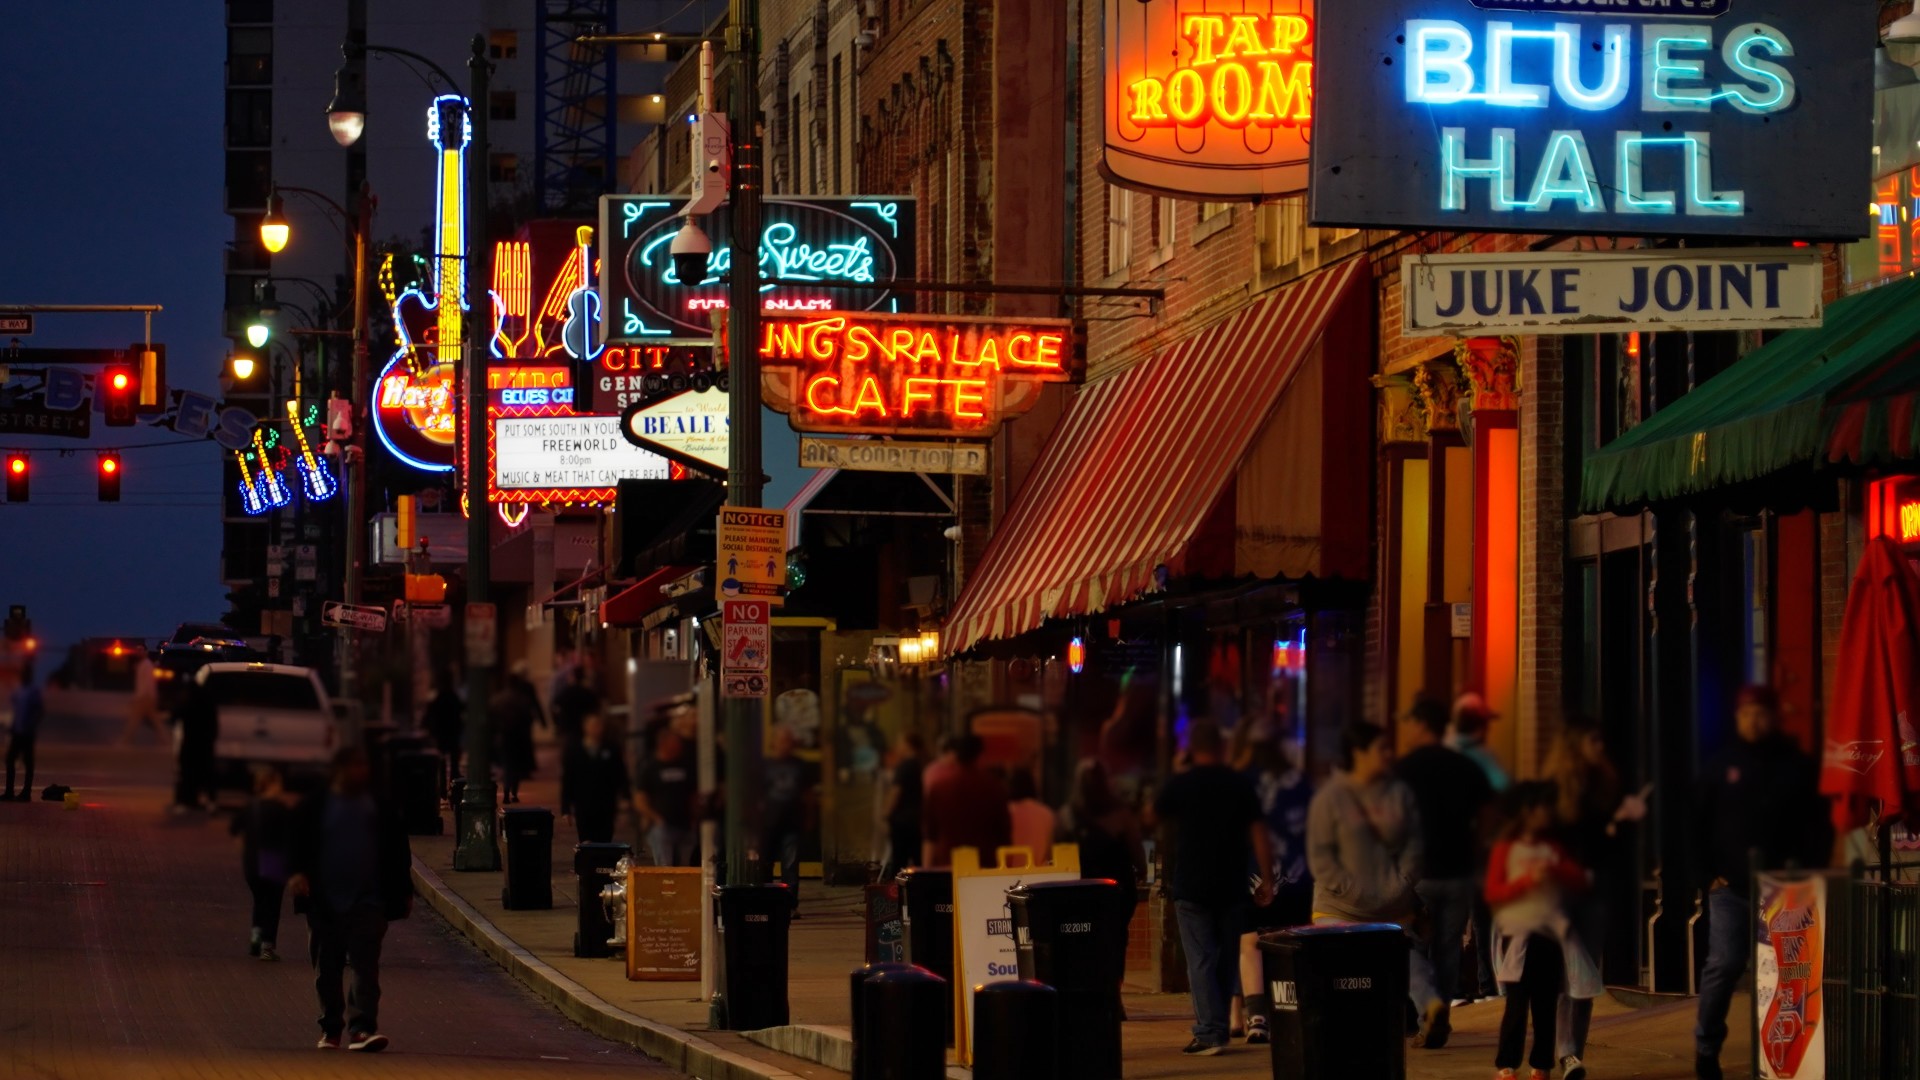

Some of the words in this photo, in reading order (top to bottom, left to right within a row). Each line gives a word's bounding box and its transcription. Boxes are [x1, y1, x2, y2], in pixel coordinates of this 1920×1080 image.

[1183, 13, 1312, 66] TAP
[1406, 19, 1796, 115] BLUES
[1129, 61, 1313, 124] ROOM
[1441, 127, 1746, 216] HALL
[763, 222, 876, 283] Sweets
[1436, 267, 1581, 316] JUKE
[1618, 262, 1789, 312] JOINT
[764, 298, 831, 310] SHACK
[9, 320, 26, 328] WAY
[381, 375, 451, 408] Hard
[502, 388, 549, 404] BLUES
[807, 376, 986, 417] CAFE
[44, 367, 259, 450] BES
[505, 424, 516, 436] PUT
[523, 424, 546, 436] SOME
[549, 423, 576, 436] SOUTH
[580, 423, 590, 434] IN
[594, 421, 621, 434] YOUR
[643, 416, 715, 434] BEALE
[543, 439, 617, 451] FREEWORLD
[560, 455, 592, 466] 8:00pm
[806, 444, 839, 463] AIR
[849, 446, 979, 468] CONDITIOND
[502, 472, 529, 484] MUSIC
[533, 472, 540, 483] &
[545, 470, 569, 483] MEAT
[573, 470, 595, 482] THAT
[725, 513, 782, 527] NOTICE
[725, 534, 747, 542] PLEASE
[749, 535, 780, 545] MAINTAIN
[723, 543, 744, 551] SOCIAL
[746, 544, 783, 553] DISTANCING
[341, 610, 358, 620] ONE
[361, 612, 378, 622] WAY
[732, 605, 760, 620] NO
[727, 626, 763, 636] PARKING
